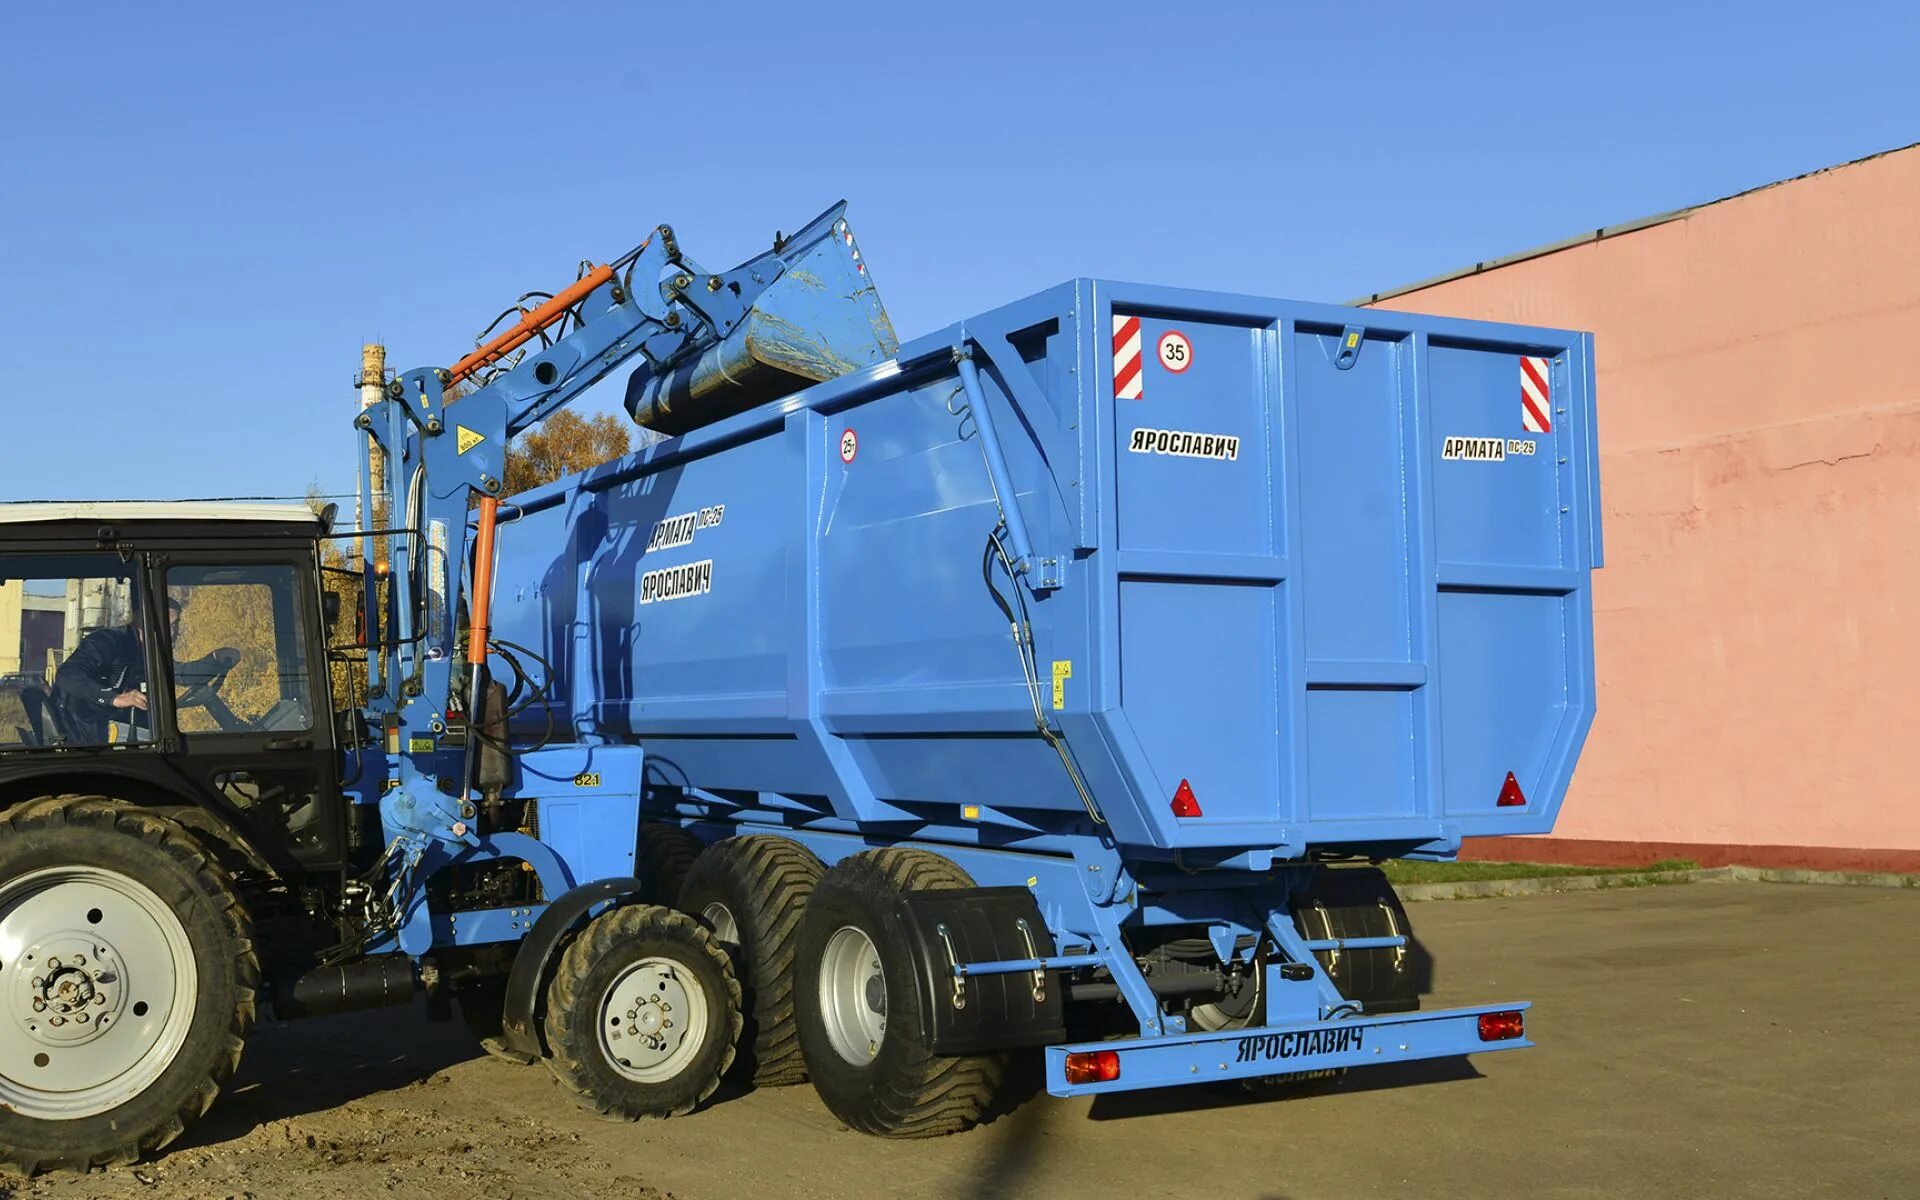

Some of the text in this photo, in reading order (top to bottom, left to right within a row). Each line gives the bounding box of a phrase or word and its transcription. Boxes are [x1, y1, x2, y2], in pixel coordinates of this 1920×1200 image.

[1165, 343, 1185, 361] 35
[1131, 430, 1238, 458] ЯРОСЛАВИЧ
[1444, 439, 1535, 459] АРМАТА ПС-25
[647, 507, 724, 550] АРМАТА ПС-25
[641, 562, 711, 601] ЯРОСЛАВИЧ
[1235, 1027, 1364, 1063] ЯРОСЛАВИЧ
